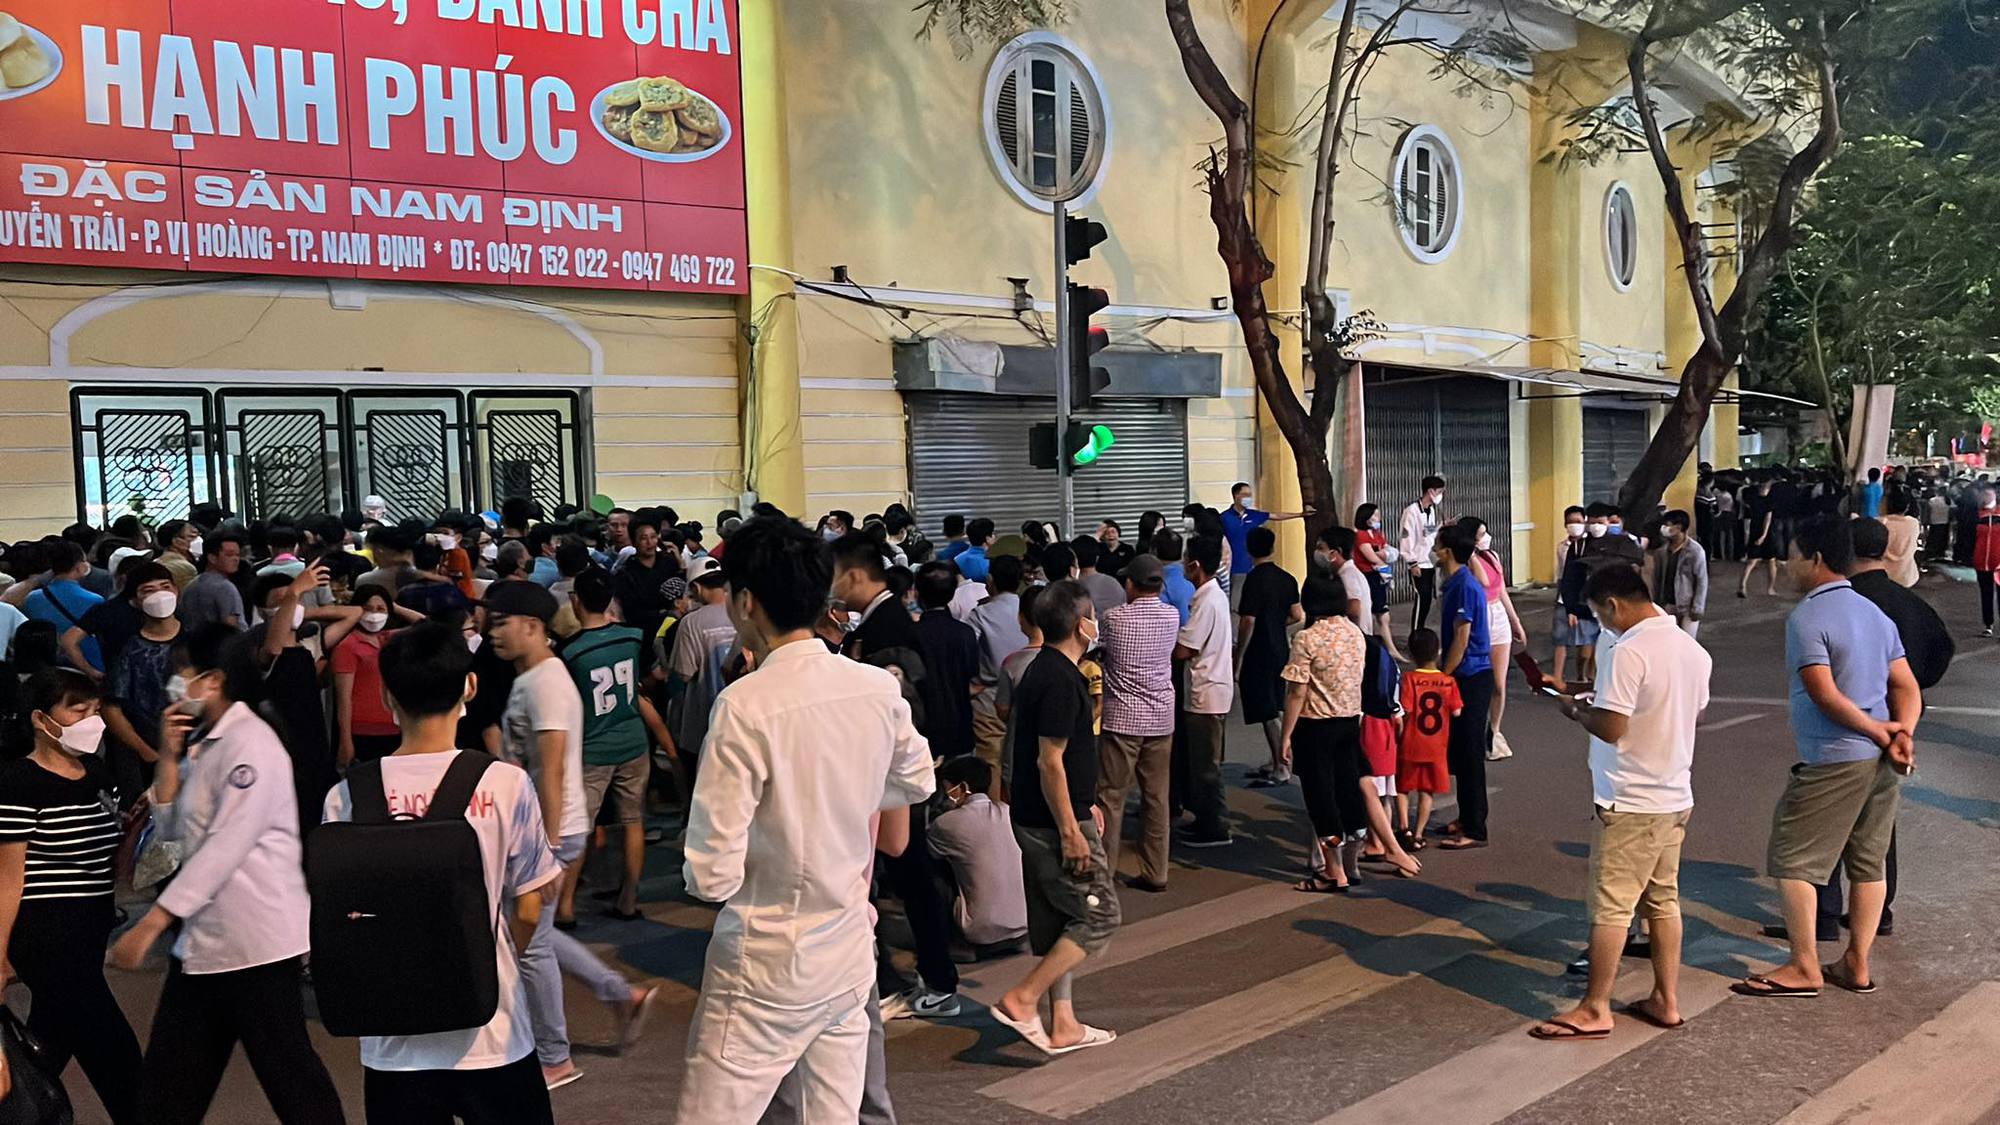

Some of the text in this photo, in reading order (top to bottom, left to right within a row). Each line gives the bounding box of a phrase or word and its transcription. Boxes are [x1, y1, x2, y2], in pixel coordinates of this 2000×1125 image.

[80, 24, 578, 165] HẠNH PHÚC
[20, 160, 622, 234] ĐẶC SẢN NAM ĐỊNH
[70, 211, 126, 252] TRÃI
[197, 218, 273, 261] HOÀNG
[377, 233, 427, 272] ĐỊNH
[450, 238, 481, 272] ĐT:
[487, 241, 533, 275] 0947
[538, 244, 570, 277] 152
[574, 247, 609, 279] 022
[621, 249, 664, 282] 0947
[669, 253, 701, 284] 469
[705, 256, 736, 287] 722
[590, 658, 634, 716] 29
[1416, 691, 1443, 736] 8
